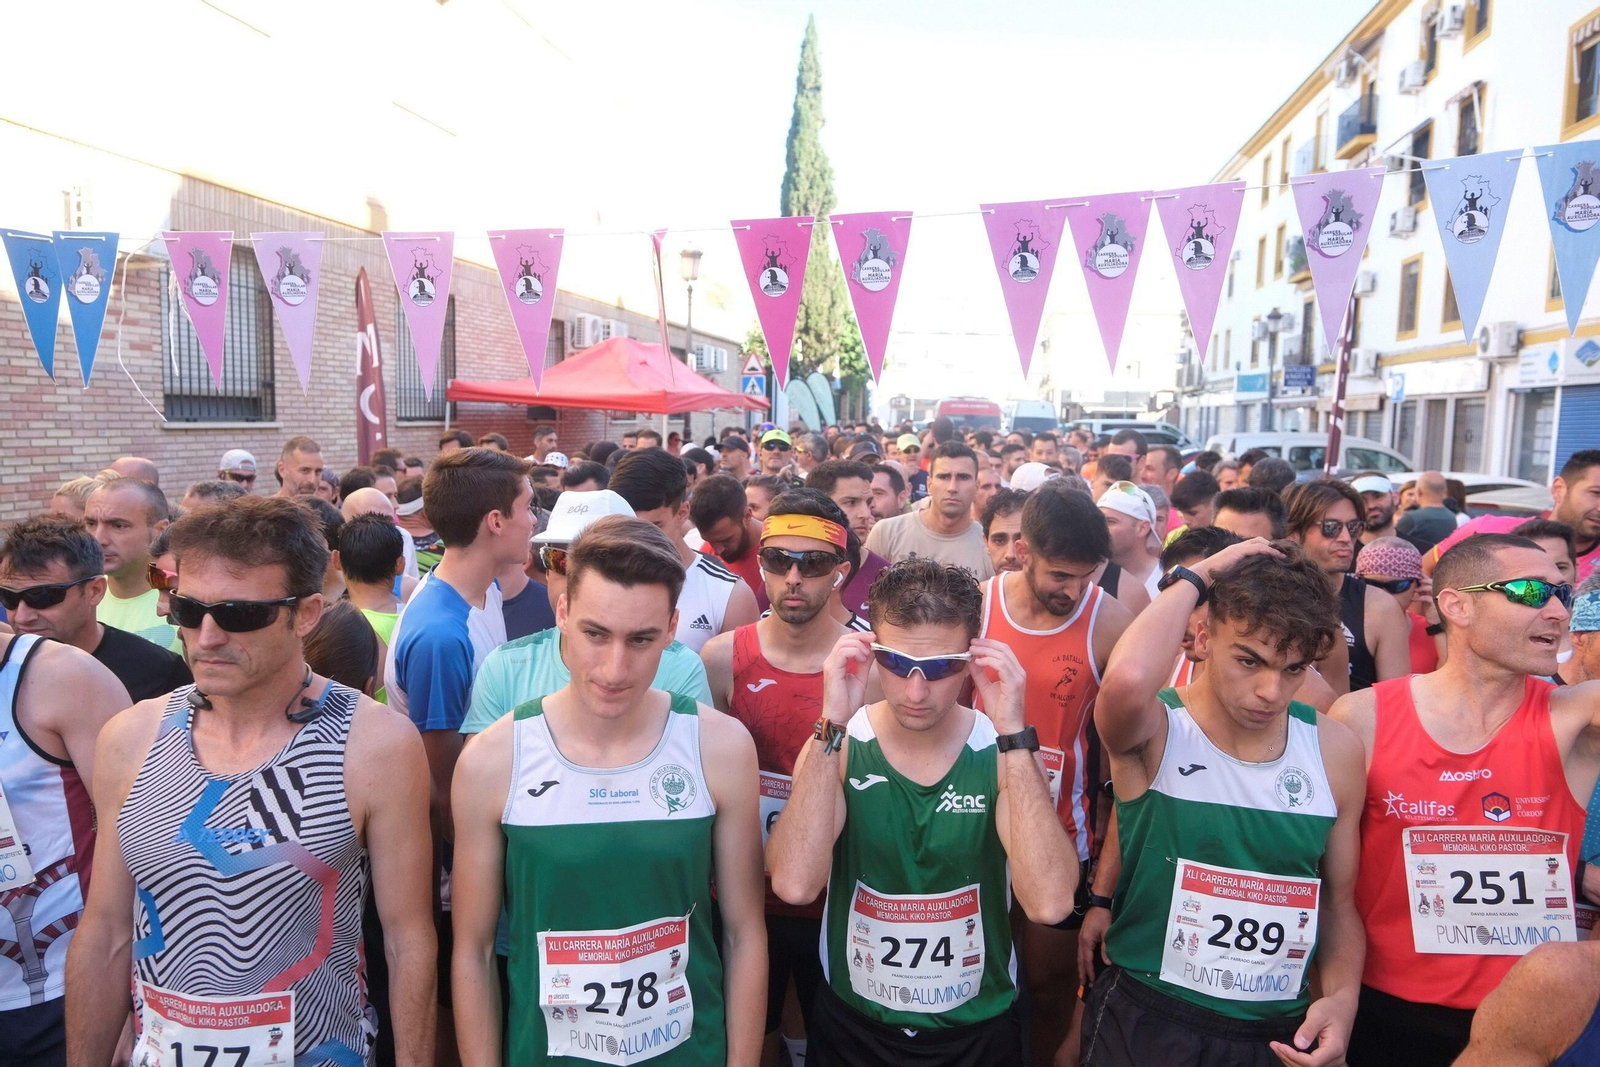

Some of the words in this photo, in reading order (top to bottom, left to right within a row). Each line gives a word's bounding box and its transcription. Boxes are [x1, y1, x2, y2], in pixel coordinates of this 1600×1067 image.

[567, 503, 588, 515] edp
[1063, 655, 1083, 664] BATALLA
[657, 765, 682, 777] ATLETISMO
[761, 778, 784, 790] CARRERA
[590, 788, 607, 798] SIG
[610, 789, 639, 798] Laboral
[952, 794, 985, 808] CAC
[1400, 800, 1455, 816] califas
[1412, 833, 1425, 843] XLI
[1427, 833, 1467, 843] CARRERA
[1469, 831, 1495, 842] MARÍA
[1442, 844, 1478, 852] MEMORIAL
[1480, 844, 1497, 852] KIKO
[1186, 869, 1198, 880] XLI
[1200, 872, 1238, 887] CARRERA
[1240, 878, 1264, 892] MARÍA
[1450, 870, 1534, 906] 251
[858, 890, 867, 903] XLI
[866, 896, 899, 911] CARRERA
[901, 901, 925, 912] MARÍA
[1213, 886, 1245, 899] MEMORIAL
[1247, 891, 1263, 902] KIKO
[877, 910, 908, 920] MEMORIAL
[910, 912, 925, 921] KIKO
[1207, 914, 1285, 956] 289
[549, 941, 560, 951] XLI
[563, 940, 602, 951] CARRERA
[605, 936, 630, 951] MARÍA
[579, 952, 613, 962] MEMORIAL
[615, 948, 630, 961] KIKO
[880, 936, 955, 968] 274
[1231, 956, 1250, 964] PARRADO
[584, 971, 659, 1017] 278
[146, 989, 158, 1001] XLI
[159, 995, 187, 1012] CARRERA
[189, 1004, 216, 1016] MARÍA
[167, 1009, 197, 1025] MEMORIAL
[199, 1016, 217, 1026] KIKO
[171, 1042, 250, 1067] 177
